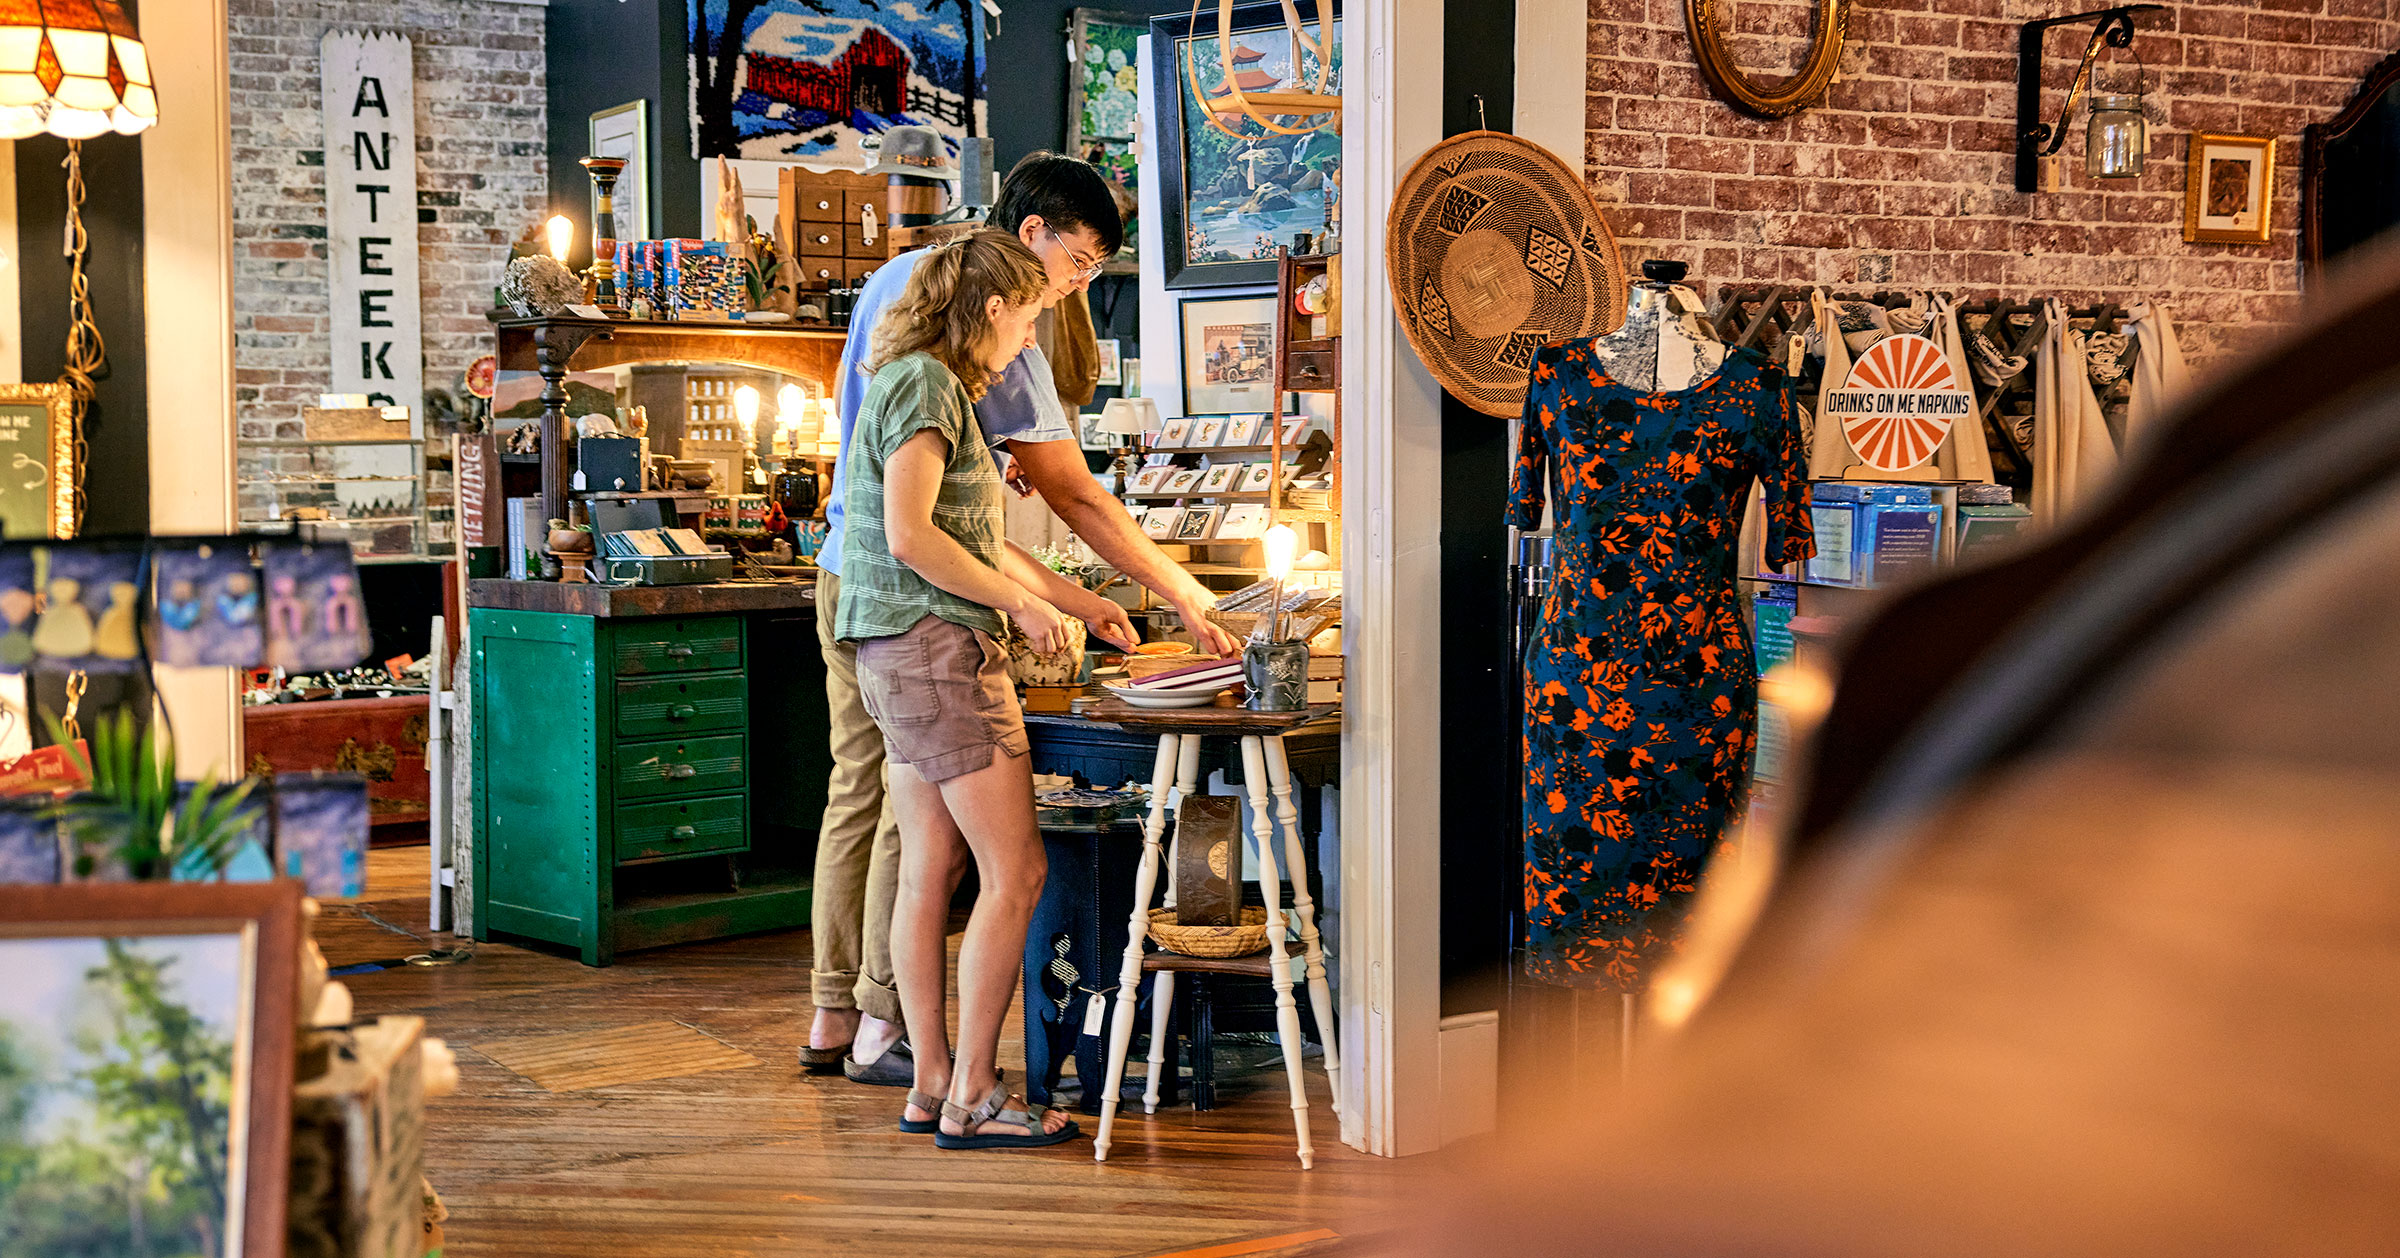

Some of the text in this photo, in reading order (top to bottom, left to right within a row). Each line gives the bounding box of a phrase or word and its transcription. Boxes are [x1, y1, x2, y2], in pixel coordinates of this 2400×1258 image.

[1828, 392, 1970, 414] DRINKS ON ME NAPKINS
[460, 445, 486, 574] METHING
